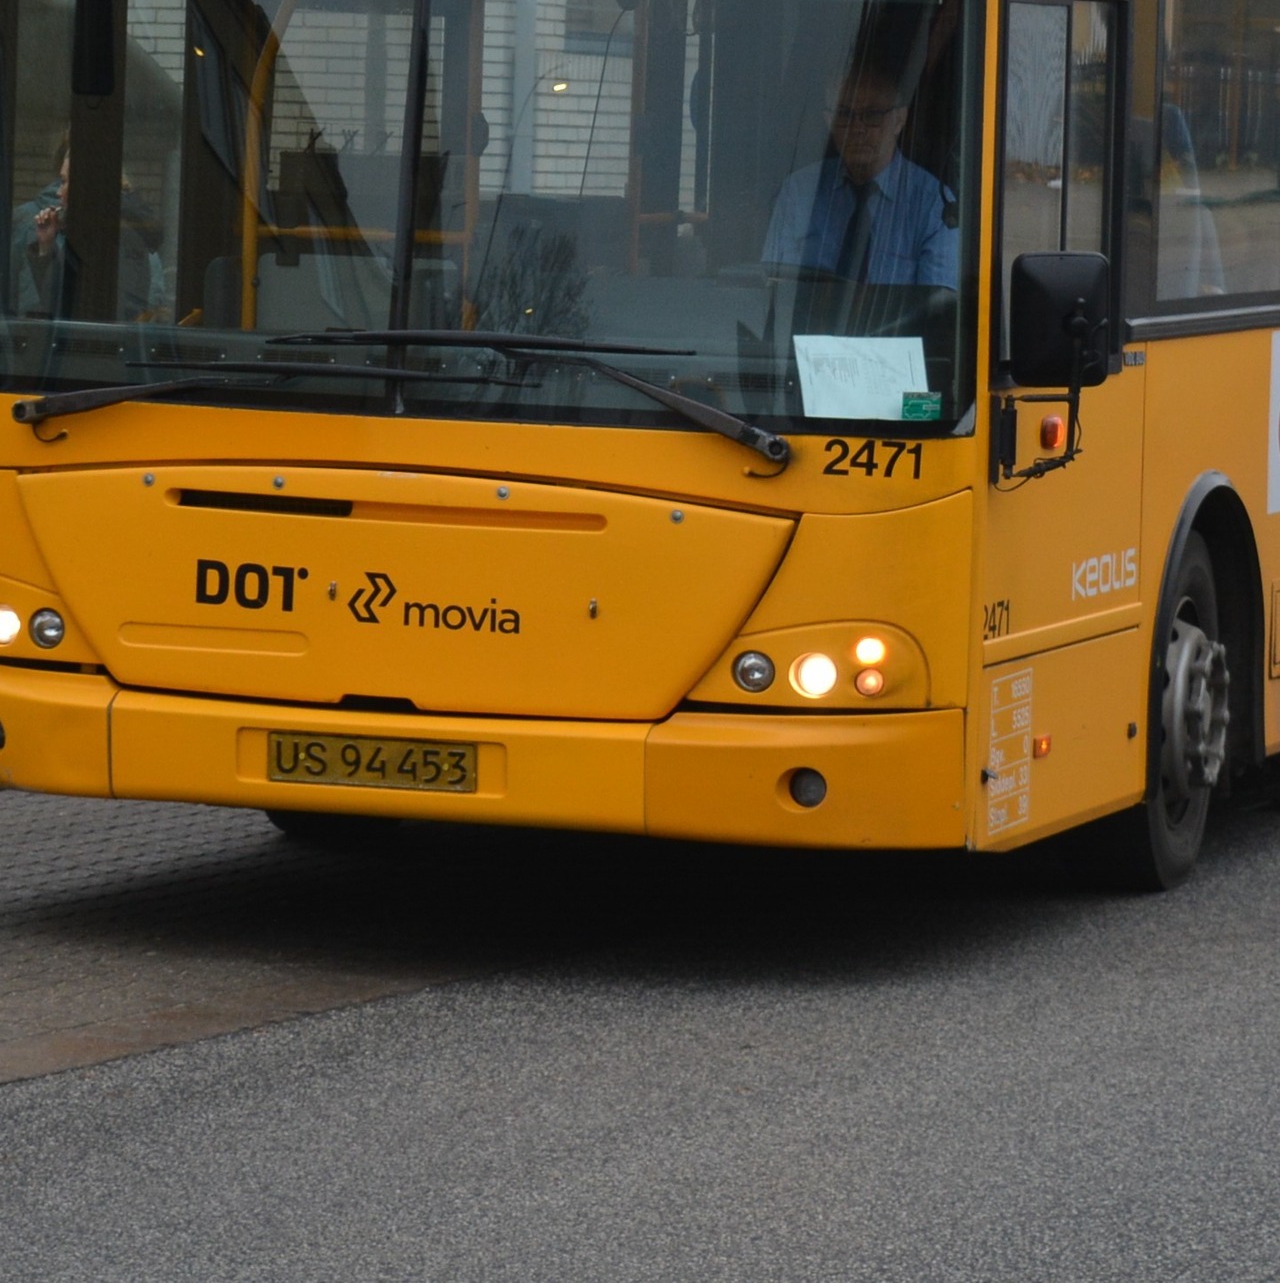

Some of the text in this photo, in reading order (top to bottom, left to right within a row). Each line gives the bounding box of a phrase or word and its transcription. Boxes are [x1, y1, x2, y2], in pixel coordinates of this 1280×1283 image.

[822, 438, 924, 480] 2471
[195, 558, 310, 613] DOT
[402, 597, 521, 635] movia
[275, 739, 468, 786] US 94 453
